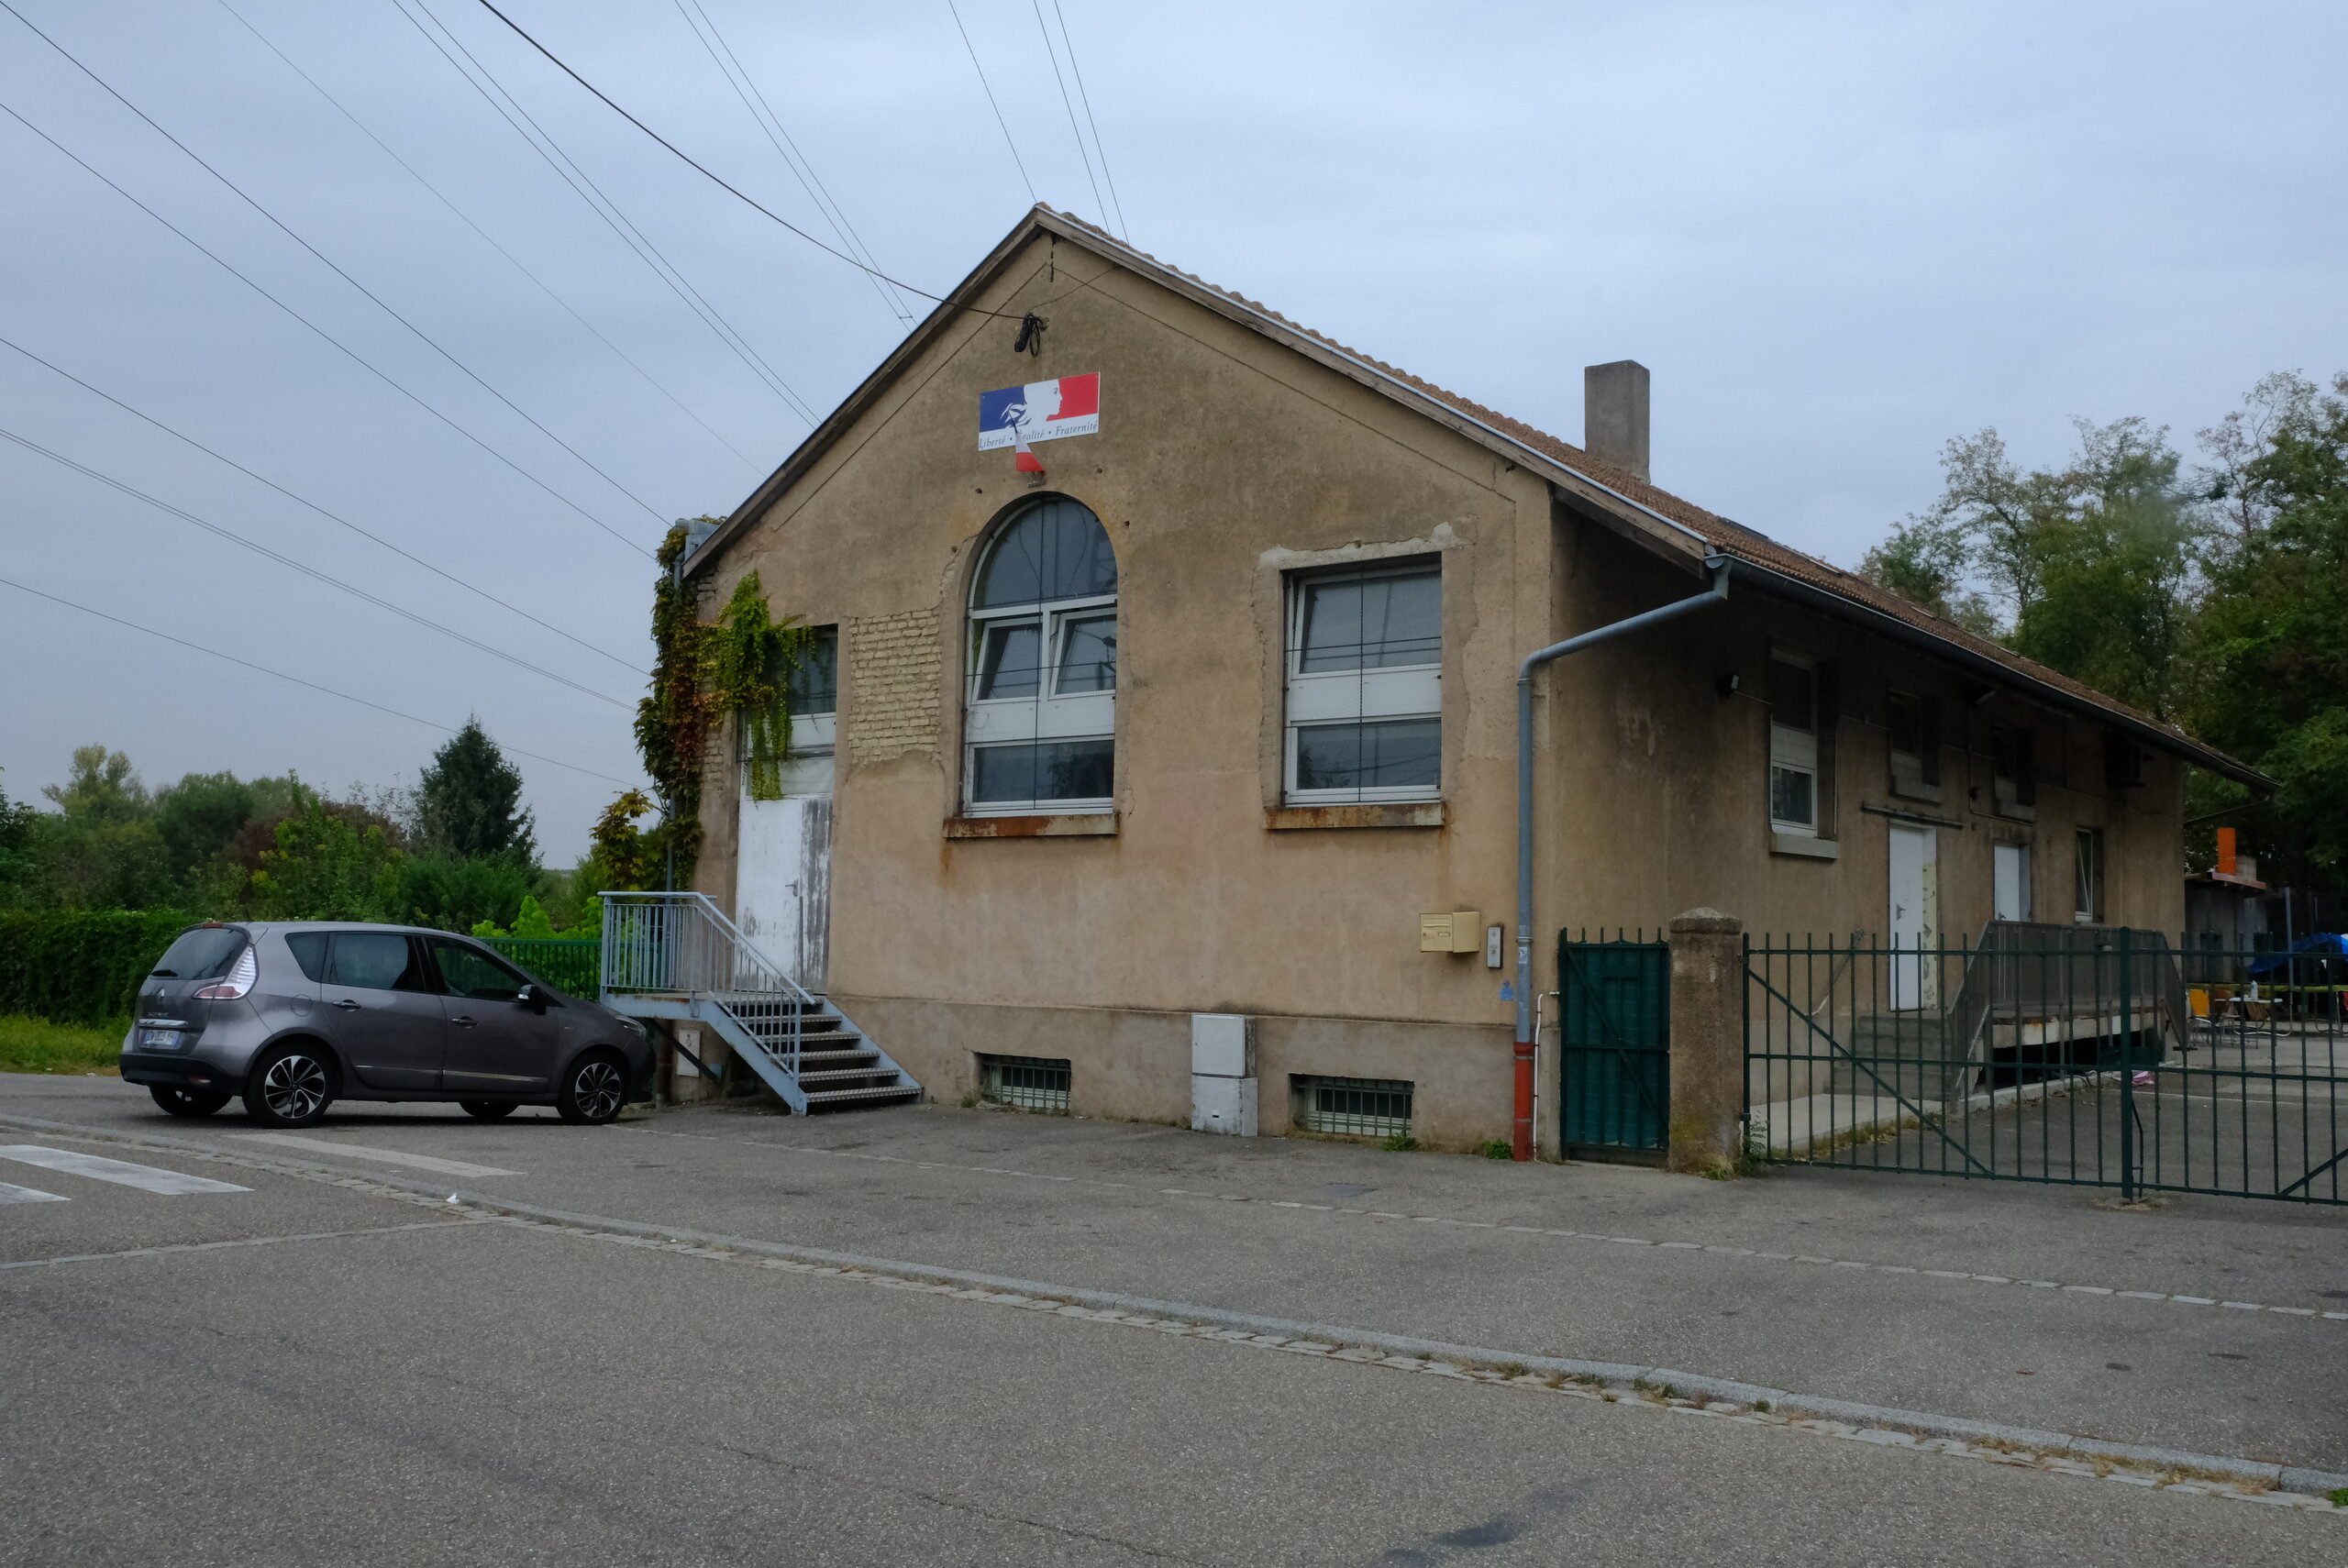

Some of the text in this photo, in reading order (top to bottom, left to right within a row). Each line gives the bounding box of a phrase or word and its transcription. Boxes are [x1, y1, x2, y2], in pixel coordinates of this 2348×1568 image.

[979, 422, 1098, 449] Liberté galité Fraternité
